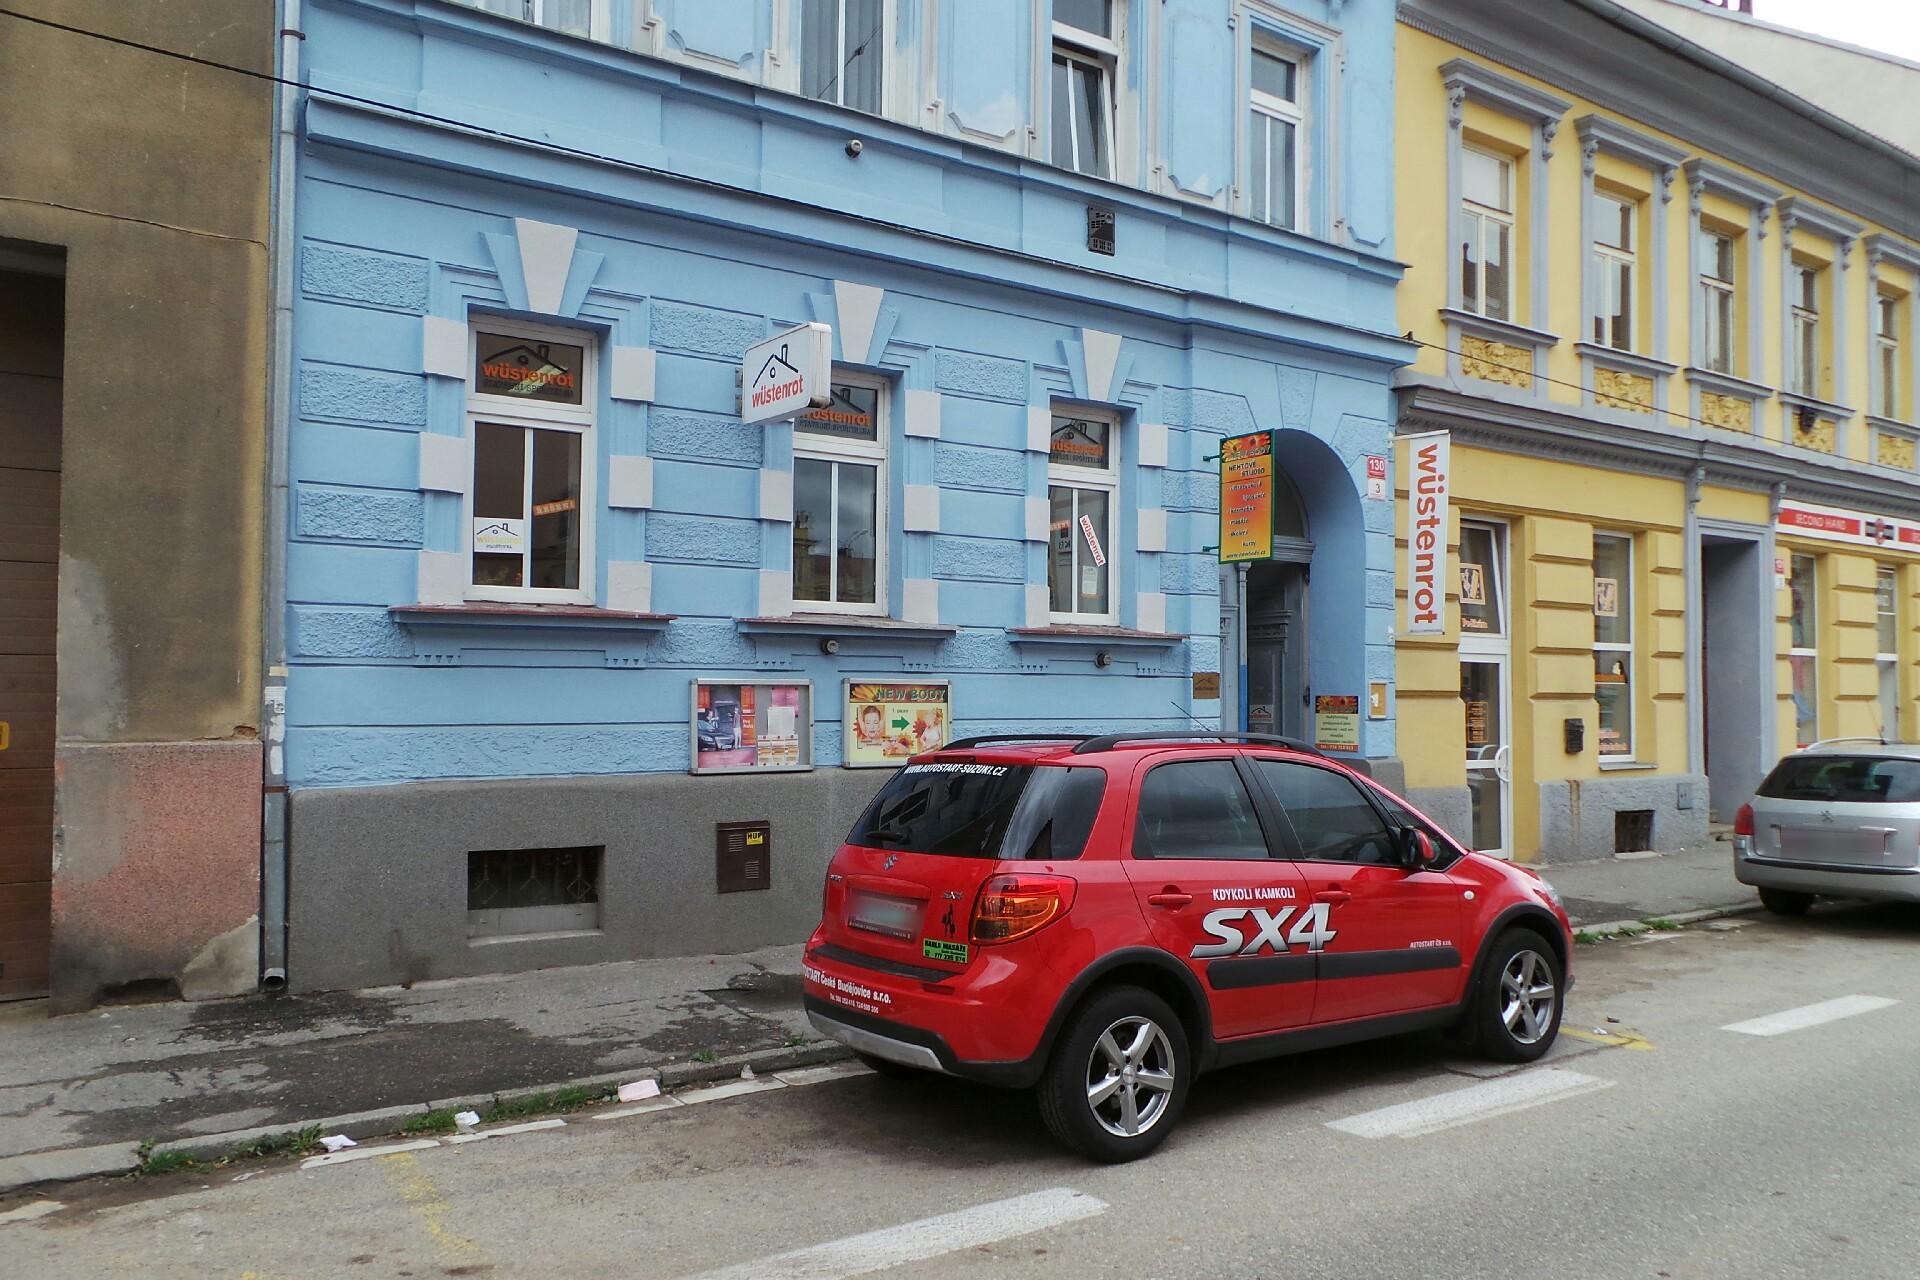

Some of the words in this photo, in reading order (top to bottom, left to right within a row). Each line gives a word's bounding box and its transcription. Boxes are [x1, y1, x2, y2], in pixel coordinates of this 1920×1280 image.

[482, 361, 576, 388] wüstenrot
[752, 374, 804, 409] wüstenrot
[1375, 483, 1380, 494] 3
[1081, 517, 1104, 565] wüstenrot
[1414, 443, 1445, 624] wüstenrot
[876, 687, 907, 700] NEW
[911, 688, 945, 701] BODY
[747, 832, 762, 840] HUP
[1212, 888, 1253, 900] KDYKOLI
[1255, 887, 1295, 899] KAMKOLI
[1190, 903, 1337, 959] SX4
[837, 979, 872, 998] Budějovice
[873, 991, 892, 1004] s.r.o.
